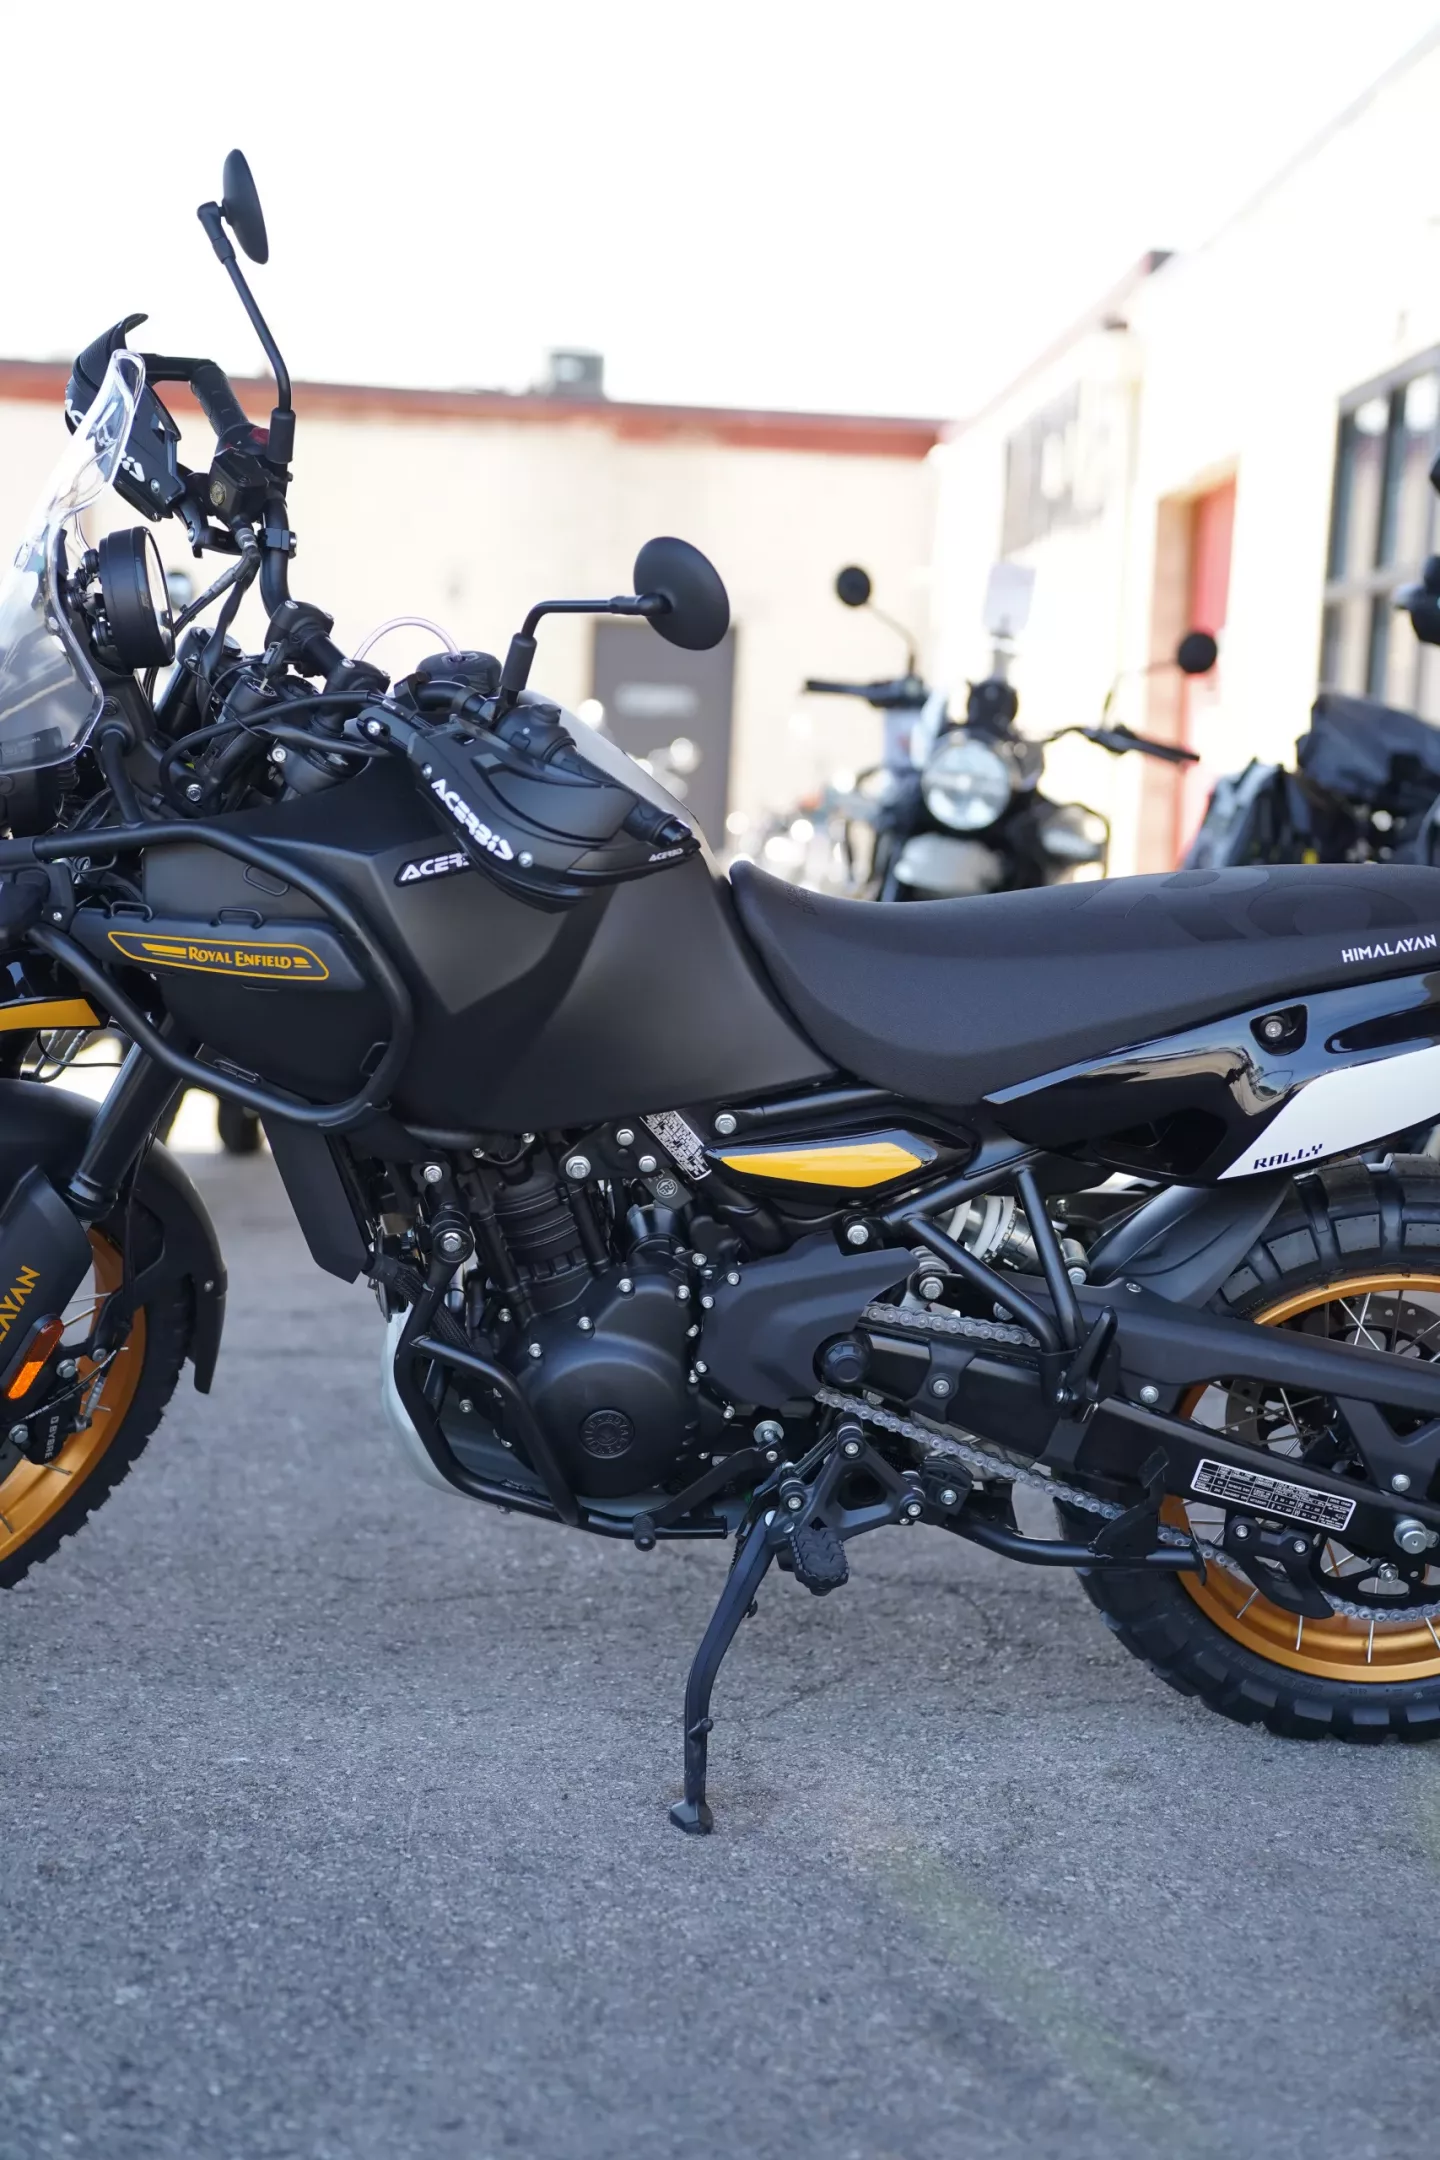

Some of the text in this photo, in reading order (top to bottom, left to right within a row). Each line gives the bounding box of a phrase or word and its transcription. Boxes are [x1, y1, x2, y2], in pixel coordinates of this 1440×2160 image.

[431, 779, 514, 861] ACERBIS
[188, 946, 292, 969] ROYAL ENFIELD
[1341, 934, 1437, 963] HIMALAYAN
[1253, 1143, 1323, 1170] RALLY
